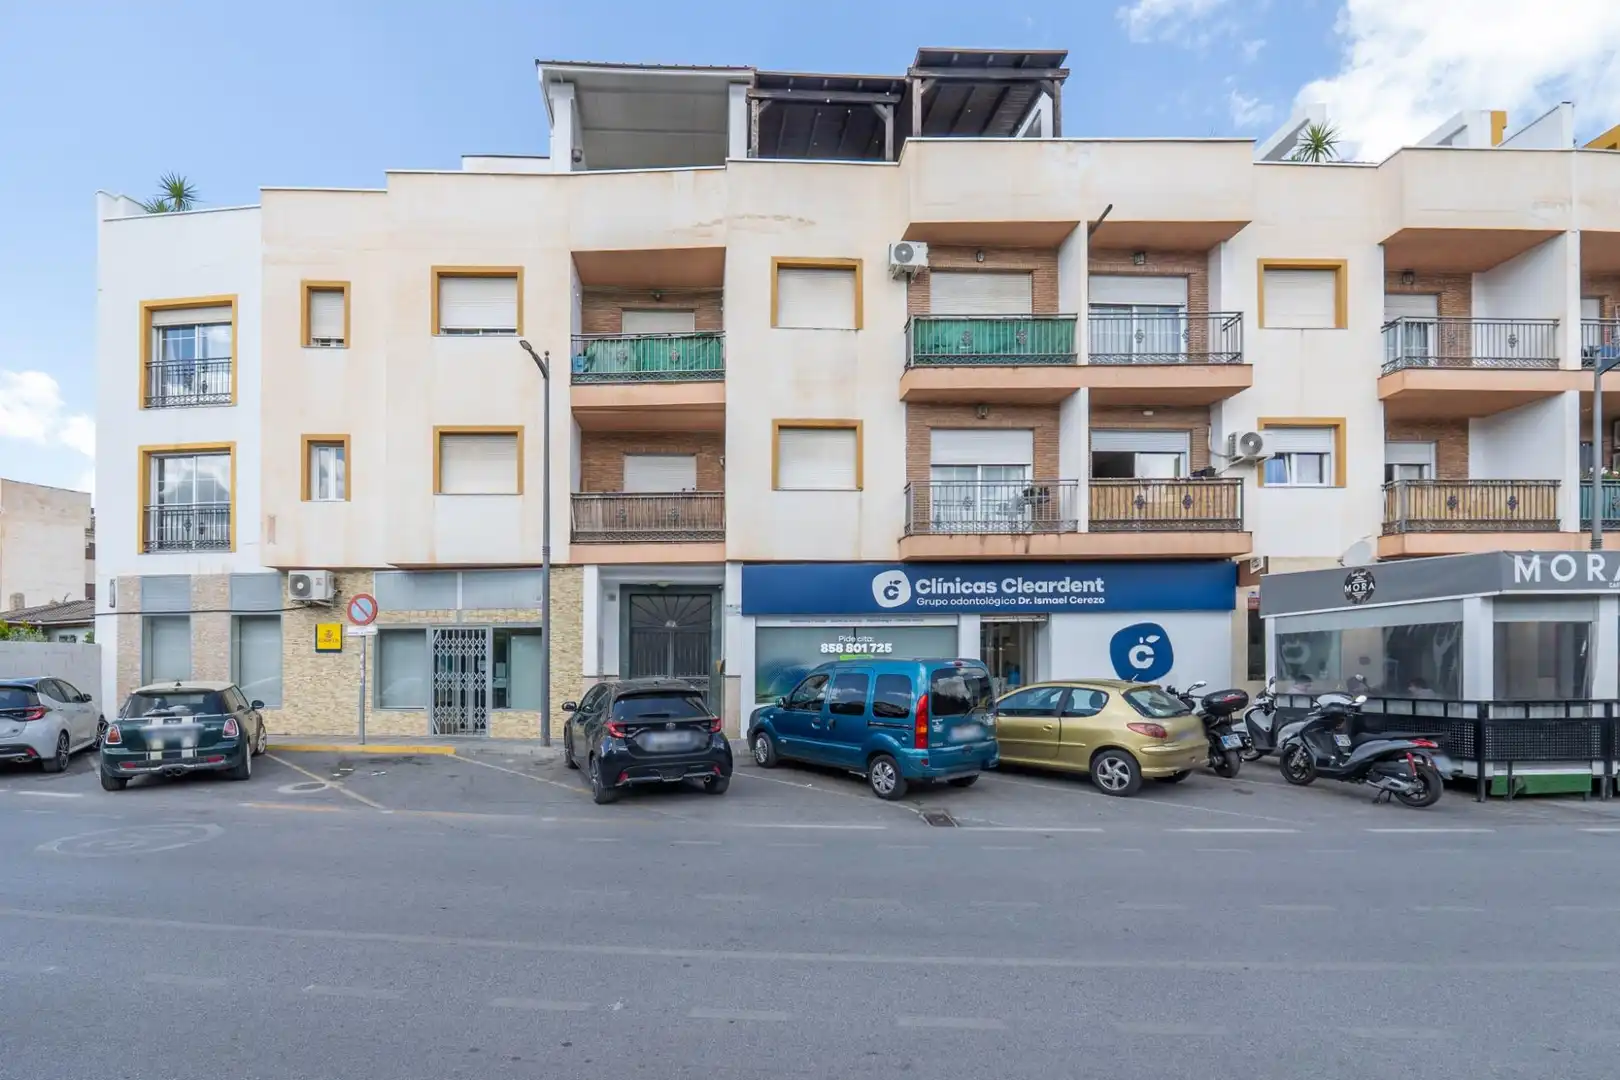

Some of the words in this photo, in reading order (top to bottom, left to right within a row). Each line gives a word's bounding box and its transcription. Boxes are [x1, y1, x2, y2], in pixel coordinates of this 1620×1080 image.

[1514, 553, 1620, 583] MOR
[915, 577, 997, 594] Clínicas
[1001, 576, 1105, 593] Cleardent
[1344, 582, 1375, 592] MORA
[916, 597, 948, 607] Grupo
[950, 597, 1016, 607] odontológico
[1034, 596, 1067, 604] Ismael
[1069, 596, 1105, 604] Cerezo
[820, 643, 844, 653] 858
[845, 643, 868, 653] 801
[869, 643, 893, 653] 725
